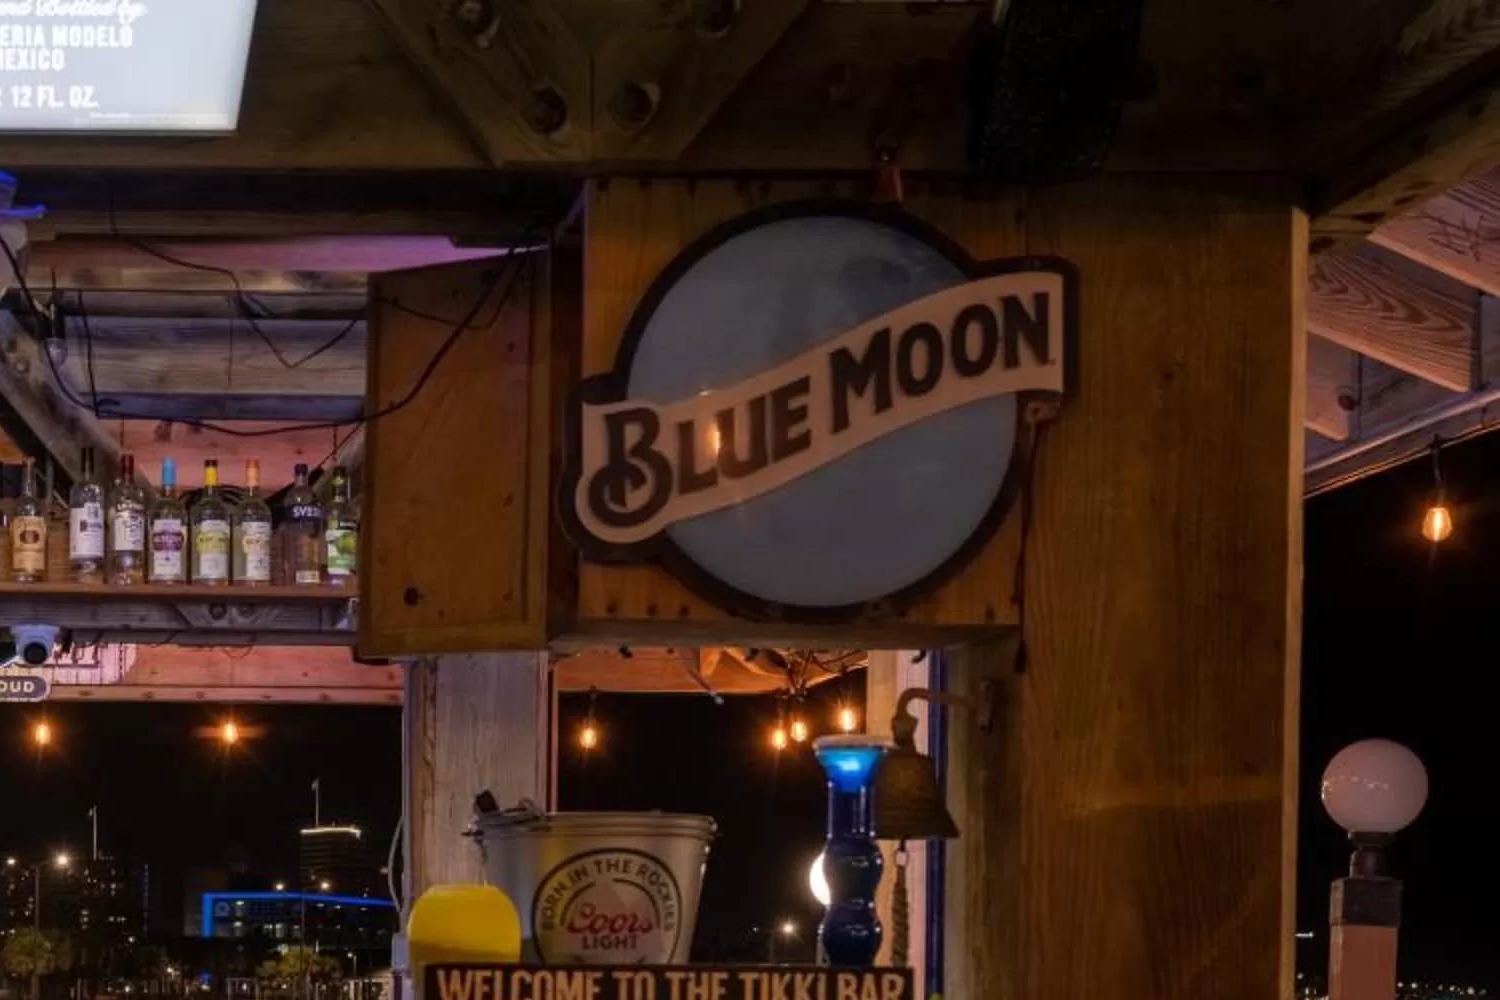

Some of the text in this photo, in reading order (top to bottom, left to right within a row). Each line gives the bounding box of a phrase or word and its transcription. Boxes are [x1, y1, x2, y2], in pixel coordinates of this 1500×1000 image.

[52, 24, 134, 48] MODELO
[11, 84, 32, 108] 12
[37, 84, 64, 109] FL.
[69, 84, 100, 109] OZ.
[588, 292, 1052, 527] BLUE MOON
[566, 864, 590, 883] IN
[593, 857, 634, 874] THE
[567, 901, 653, 934] Coors
[582, 935, 639, 949] LIGHT
